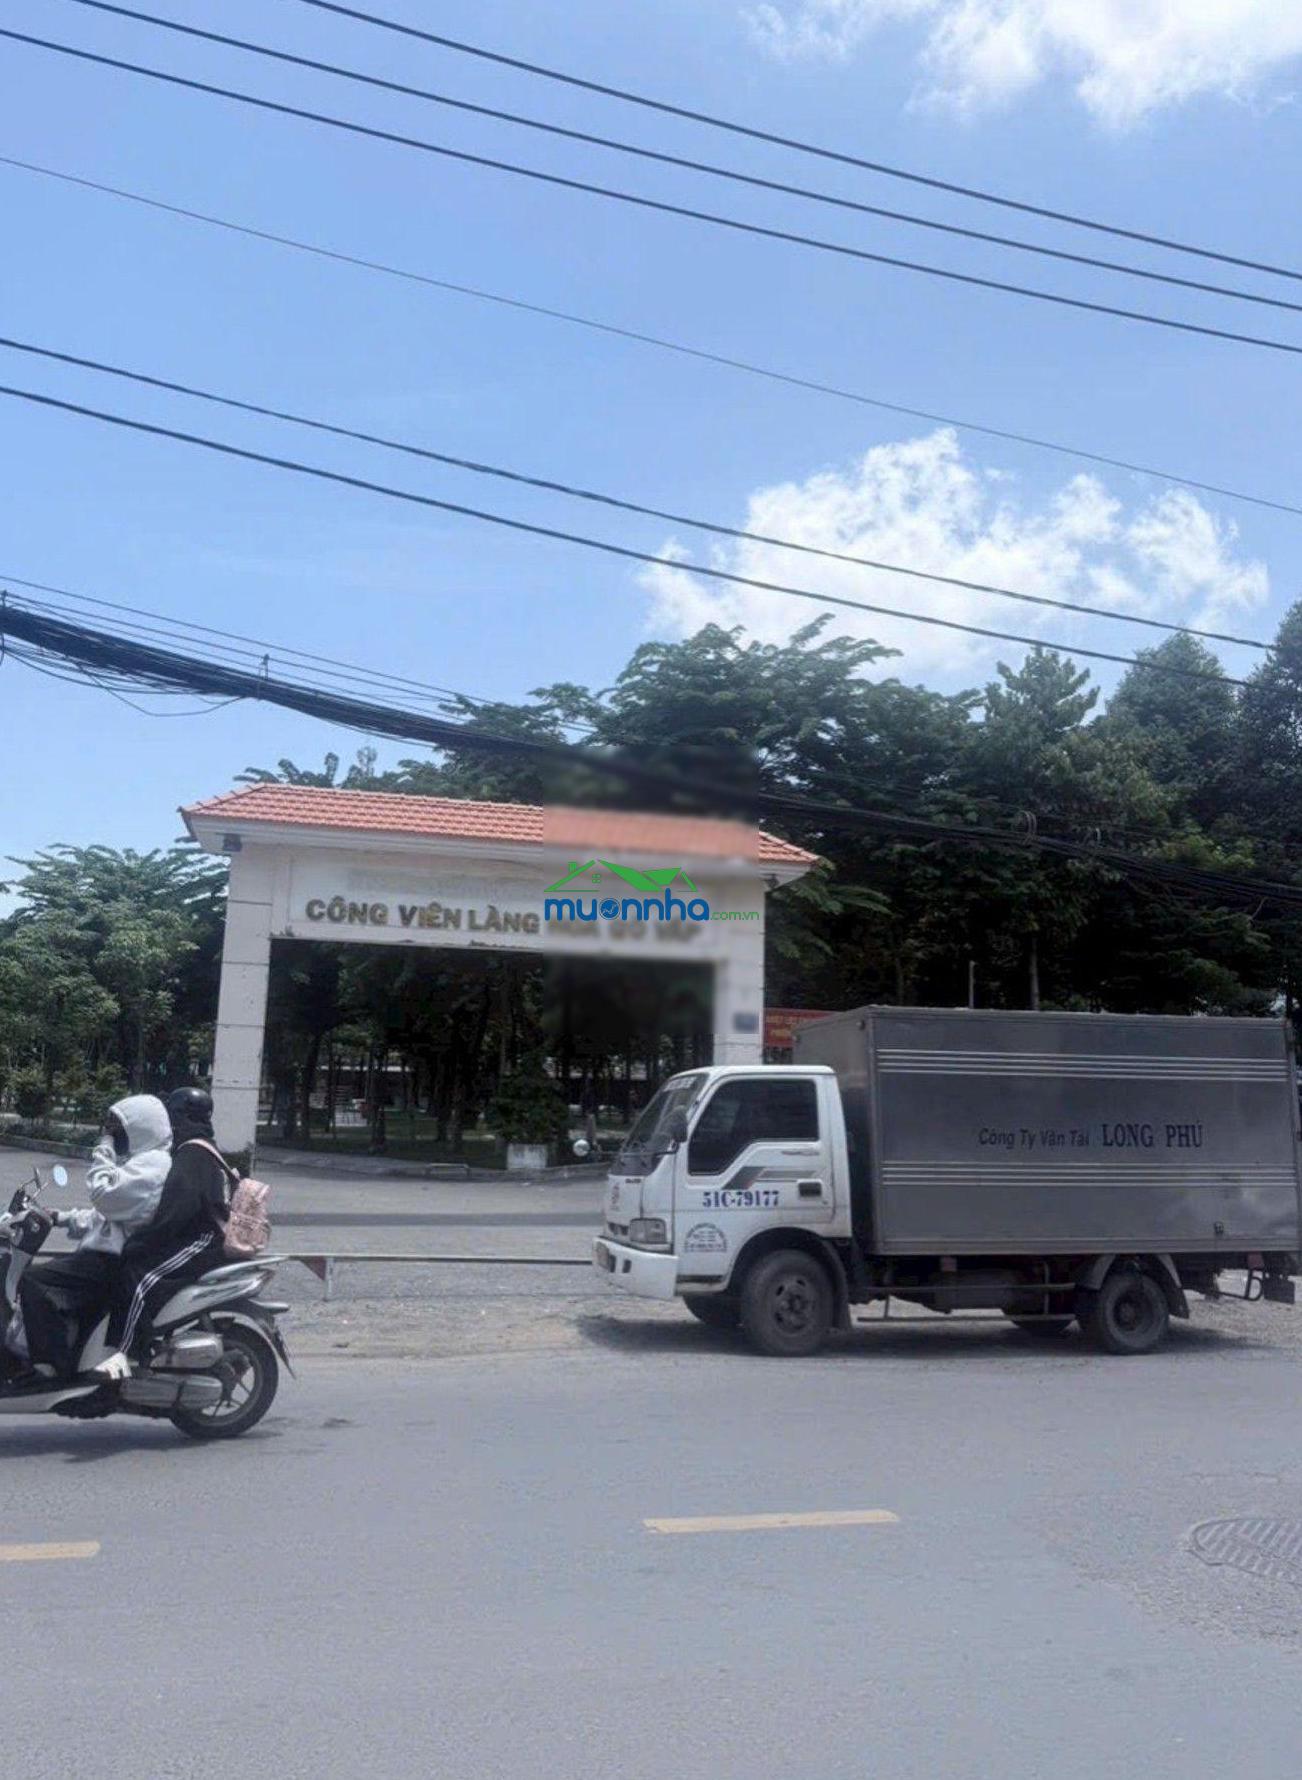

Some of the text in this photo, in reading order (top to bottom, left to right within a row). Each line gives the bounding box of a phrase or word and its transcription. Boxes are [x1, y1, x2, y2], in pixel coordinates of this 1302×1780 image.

[306, 895, 389, 925] CÔNG
[398, 901, 462, 930] VIÊN
[467, 904, 540, 934] LÀNG
[1020, 1129, 1036, 1150] Ty
[1101, 1123, 1154, 1148] LONG
[702, 1190, 779, 1207] 51C-79177
